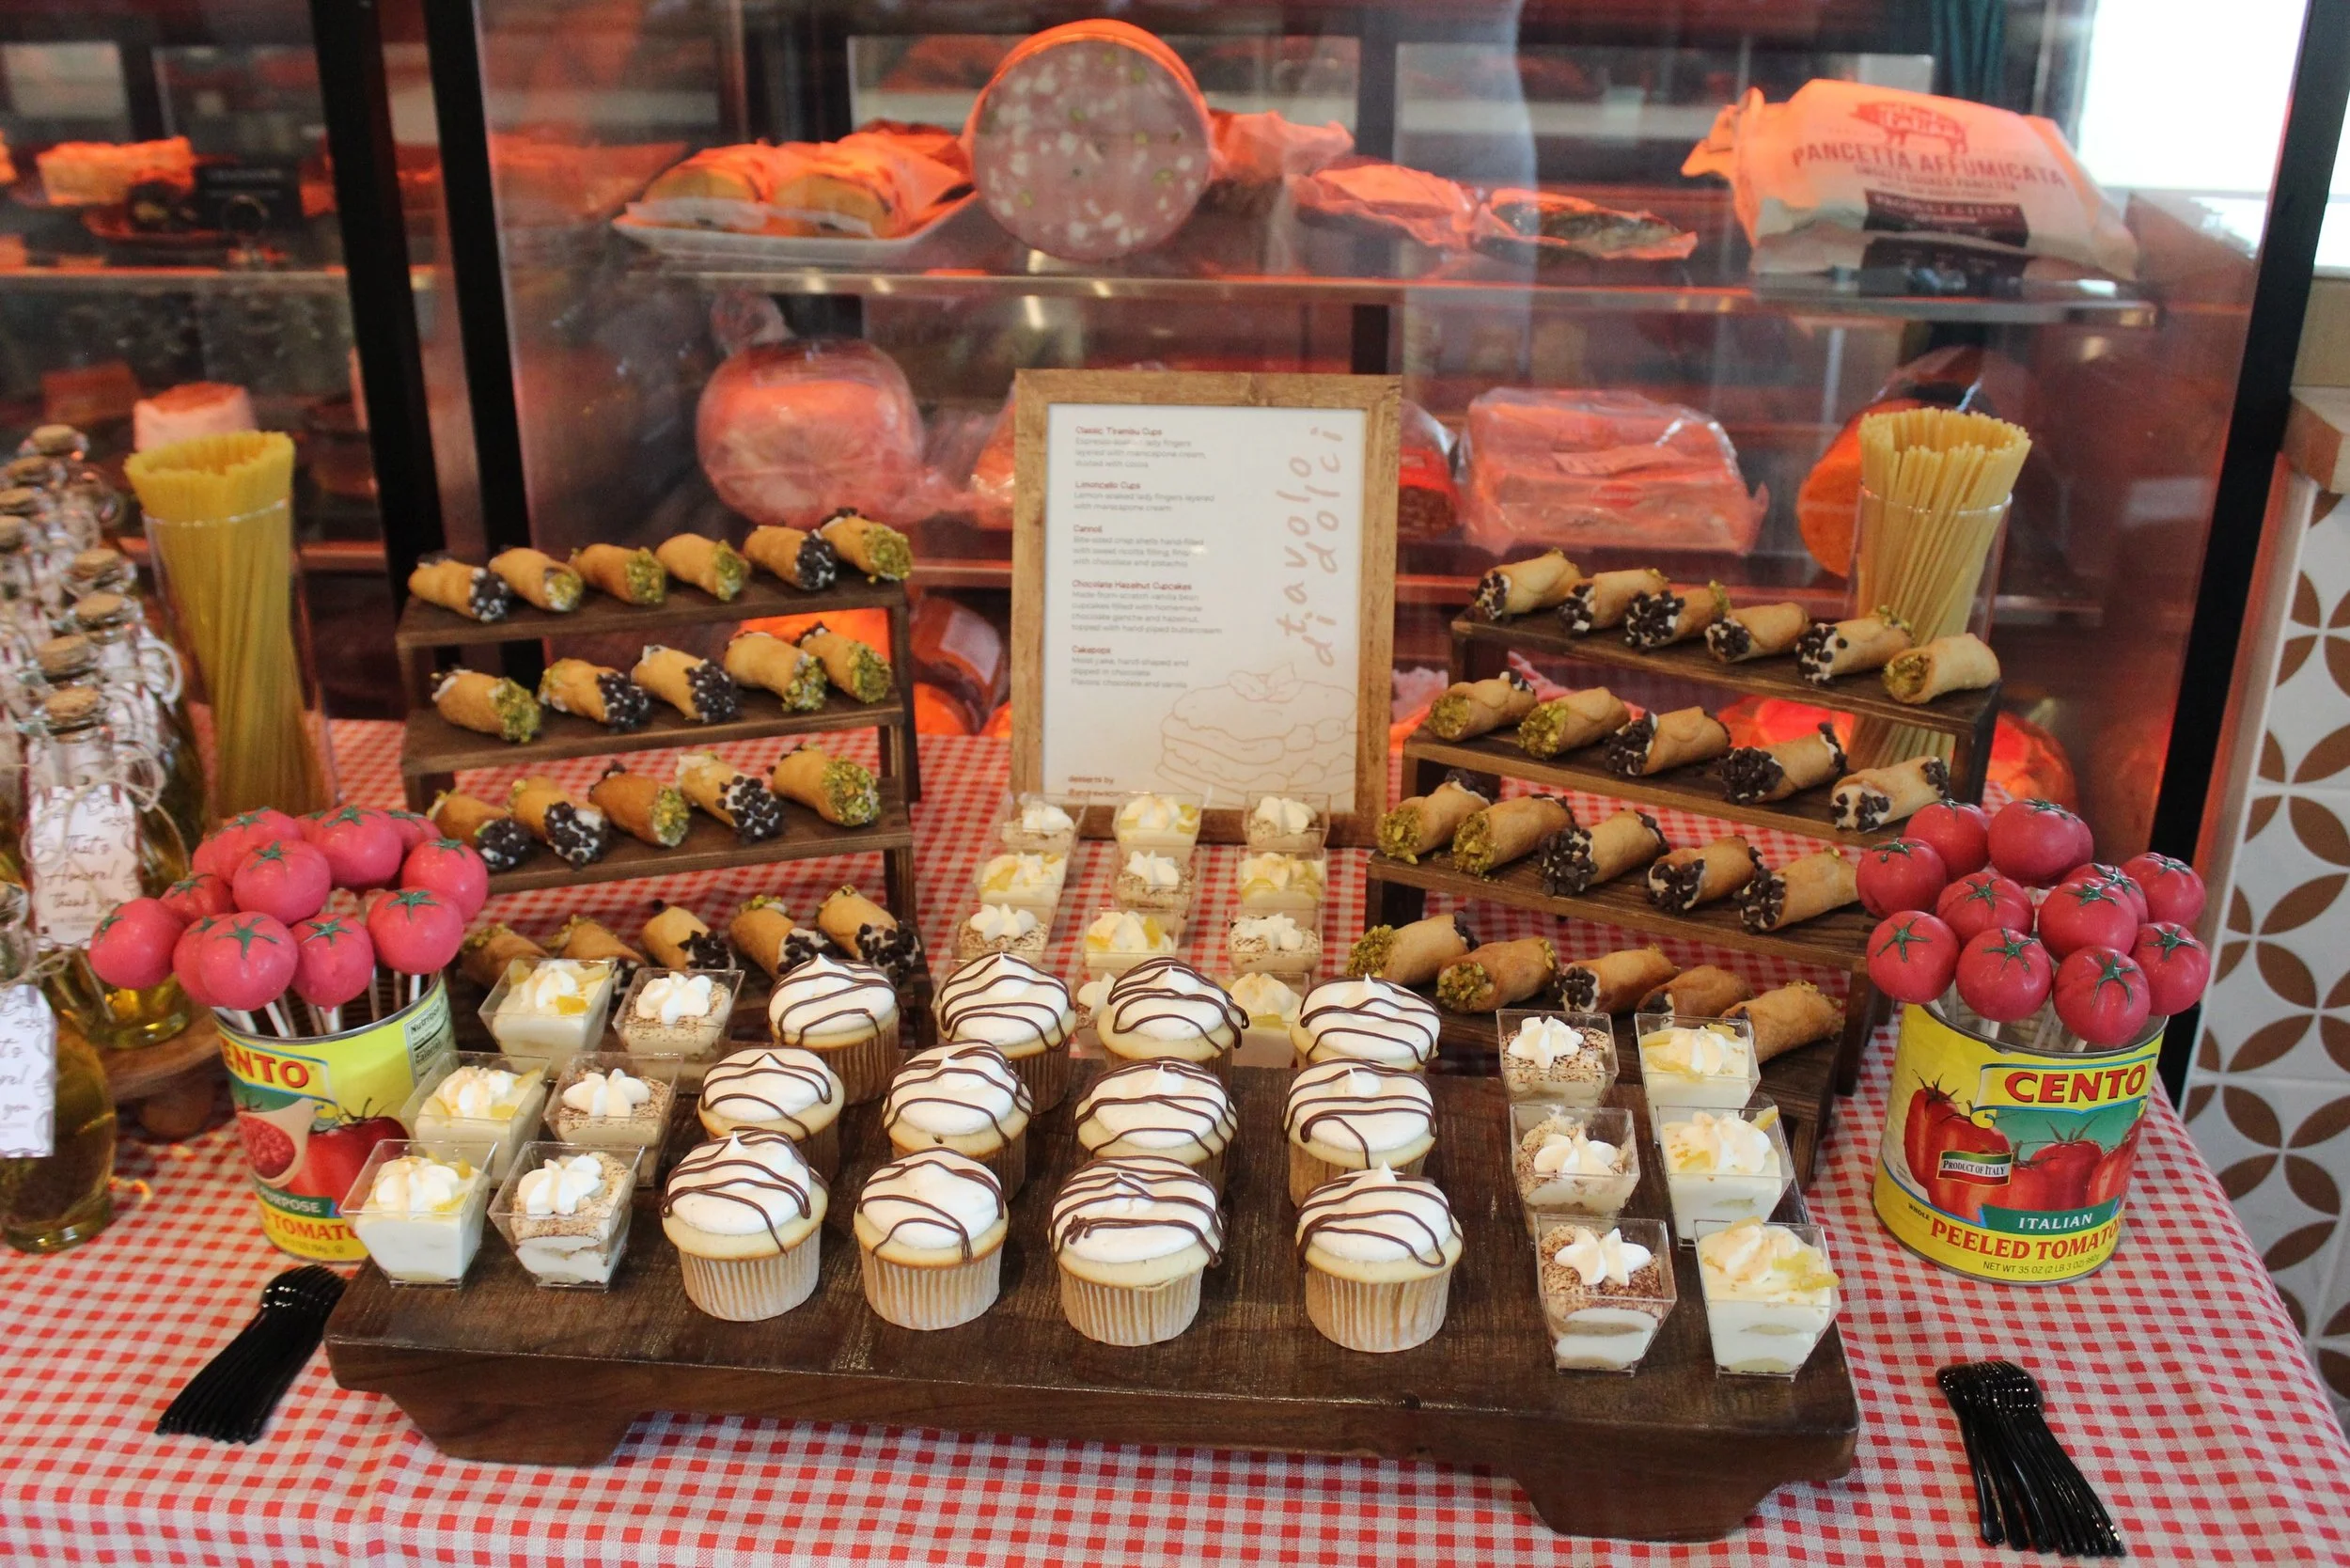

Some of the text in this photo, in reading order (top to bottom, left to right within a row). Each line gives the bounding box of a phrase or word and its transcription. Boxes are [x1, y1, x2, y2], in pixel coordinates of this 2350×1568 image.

[1791, 143, 2066, 188] PANCETTA AFFUMICATA
[1075, 426, 1103, 435] Classic
[1142, 428, 1163, 437] Cups
[1075, 480, 1141, 491] Limoncello Cups
[1073, 525, 1103, 534] Cannoli
[1276, 456, 1312, 637] tavolo
[1302, 427, 1344, 667] di dolci
[1092, 558, 1132, 567] chocolate
[1072, 580, 1193, 591] Chocolate Hazelnut Cupcakes
[219, 1037, 309, 1089] ENTO
[2004, 1064, 2147, 1104] CENTO
[1943, 1160, 2006, 1175] PRODUCT OF ITALY
[2019, 1213, 2093, 1230] ITALIAN
[1908, 1203, 1930, 1220] WHOLE
[1931, 1217, 2030, 1260] PEELED
[1983, 1261, 2000, 1271] NET
[2003, 1265, 2016, 1274] WT
[2018, 1265, 2029, 1274] 35
[2044, 1265, 2053, 1275] (2
[2055, 1263, 2064, 1273] LB
